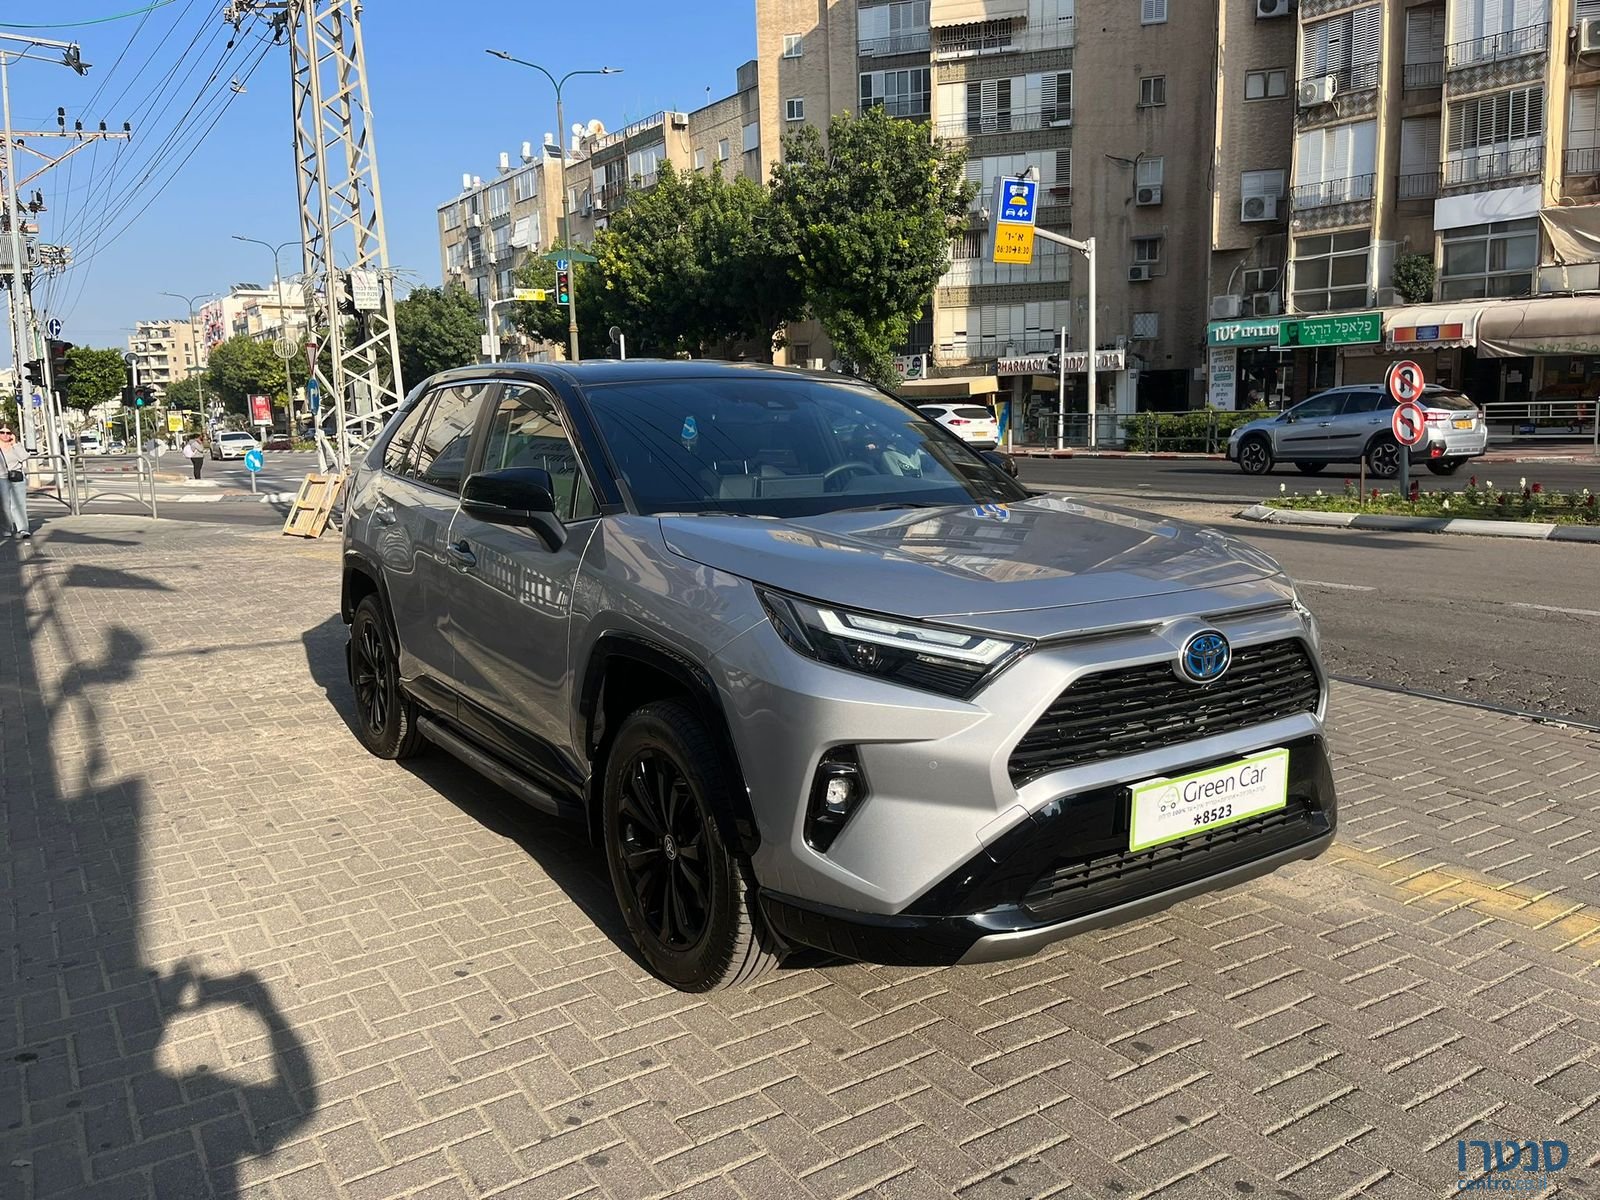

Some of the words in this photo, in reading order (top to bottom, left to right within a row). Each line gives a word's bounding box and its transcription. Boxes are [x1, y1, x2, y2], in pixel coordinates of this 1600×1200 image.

[1017, 208, 1029, 218] 4+
[1212, 324, 1241, 342] TOP
[997, 359, 1045, 373] PHARMACY
[1183, 776, 1235, 804] Green
[1238, 764, 1268, 788] Car
